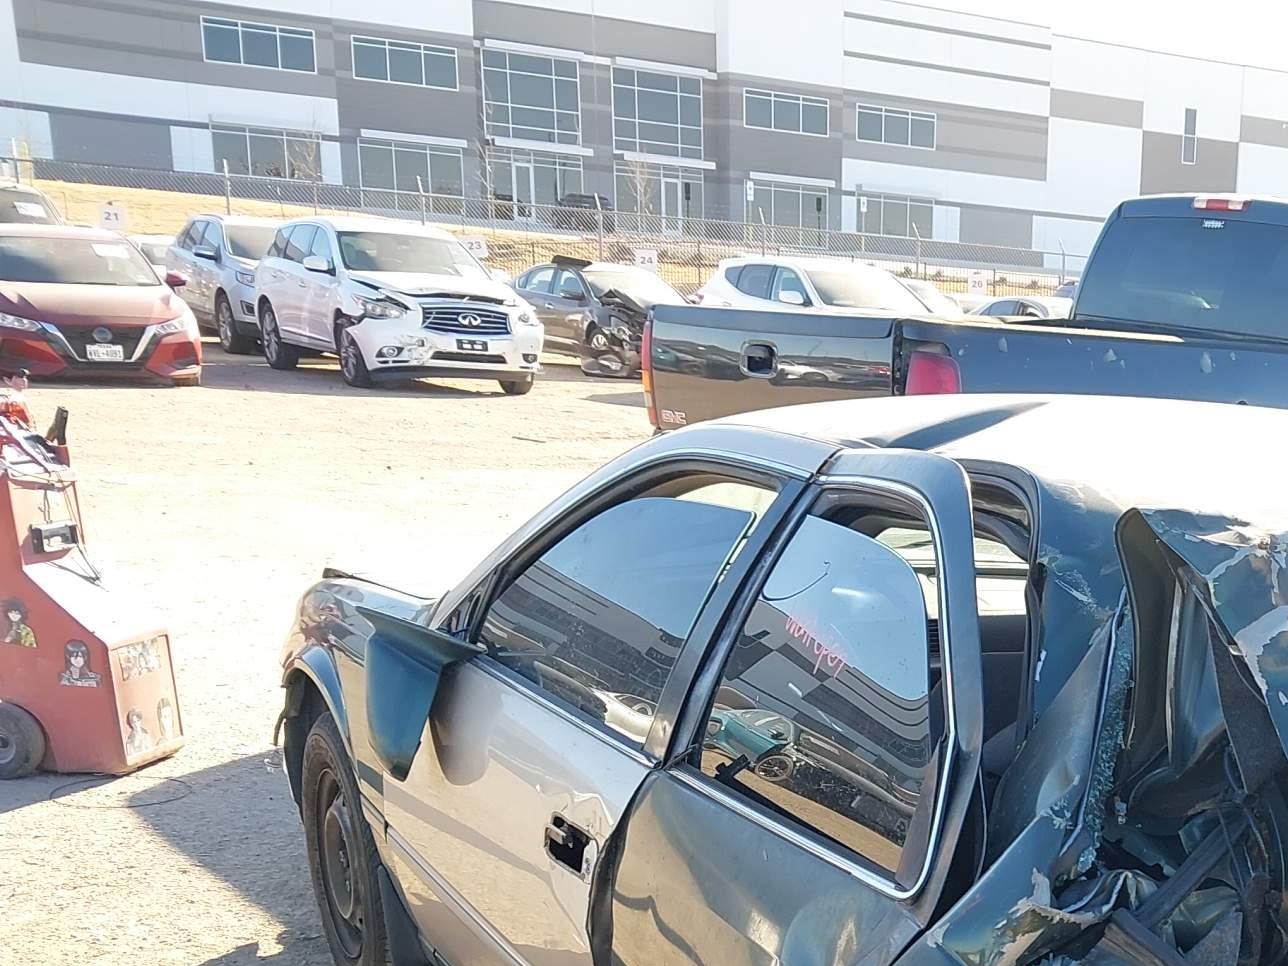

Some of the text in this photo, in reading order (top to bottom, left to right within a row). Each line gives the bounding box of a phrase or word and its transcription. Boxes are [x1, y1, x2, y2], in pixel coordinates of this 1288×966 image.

[103, 211, 119, 221] 21
[467, 240, 482, 250] 23
[639, 256, 654, 265] 24
